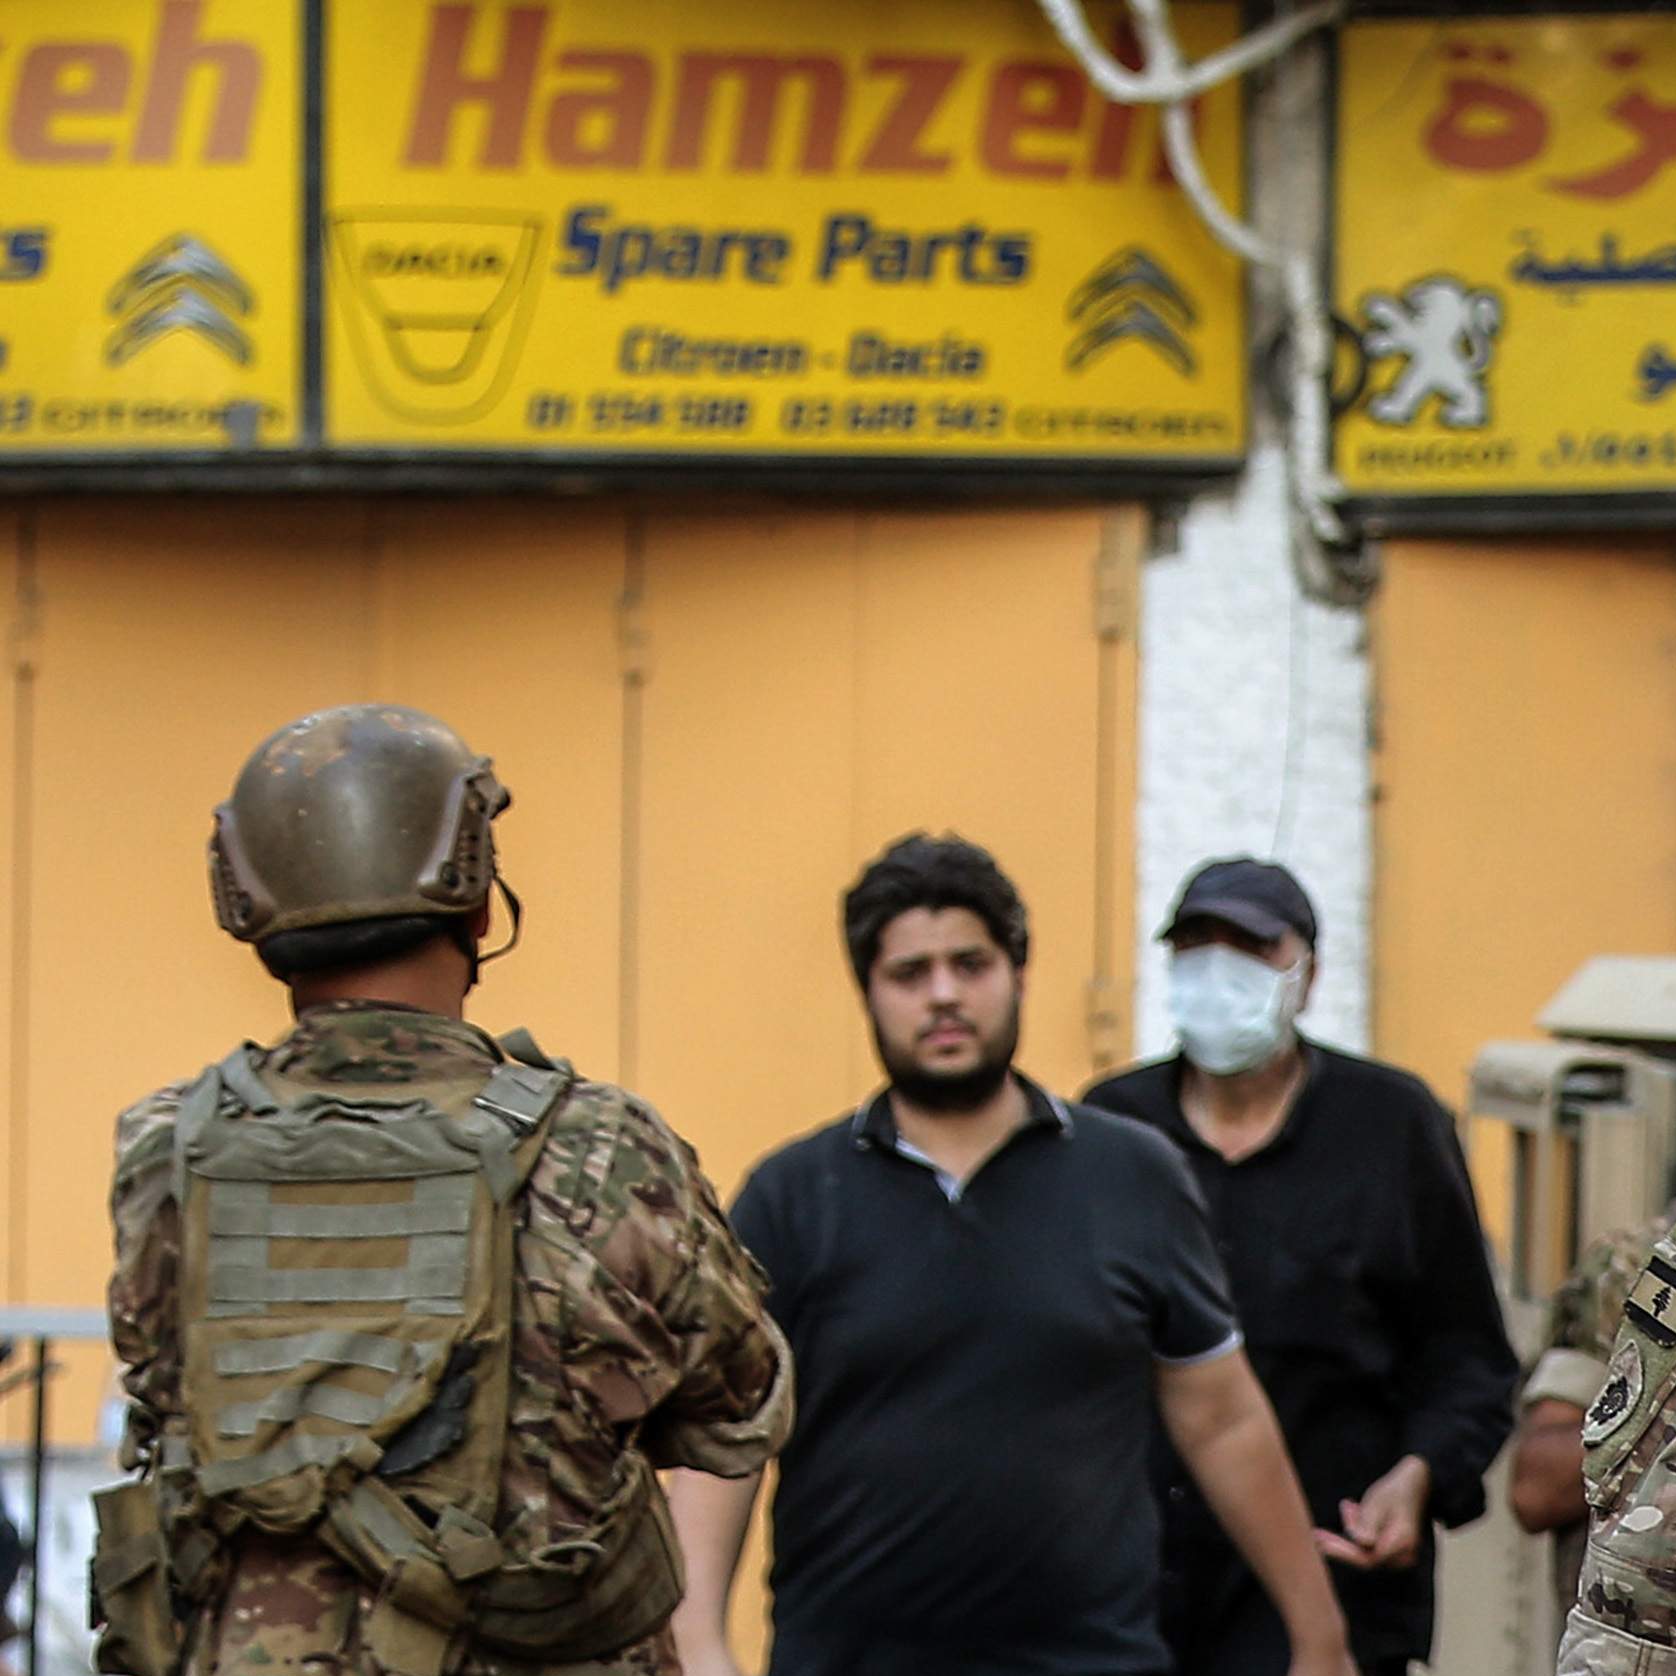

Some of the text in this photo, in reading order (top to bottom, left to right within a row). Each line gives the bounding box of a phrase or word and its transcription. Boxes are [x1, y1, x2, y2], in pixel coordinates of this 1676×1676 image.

[0, 0, 265, 166] eh
[555, 202, 1032, 295] Spare Parts
[618, 325, 808, 378] Citroen
[847, 330, 986, 381] Dacia
